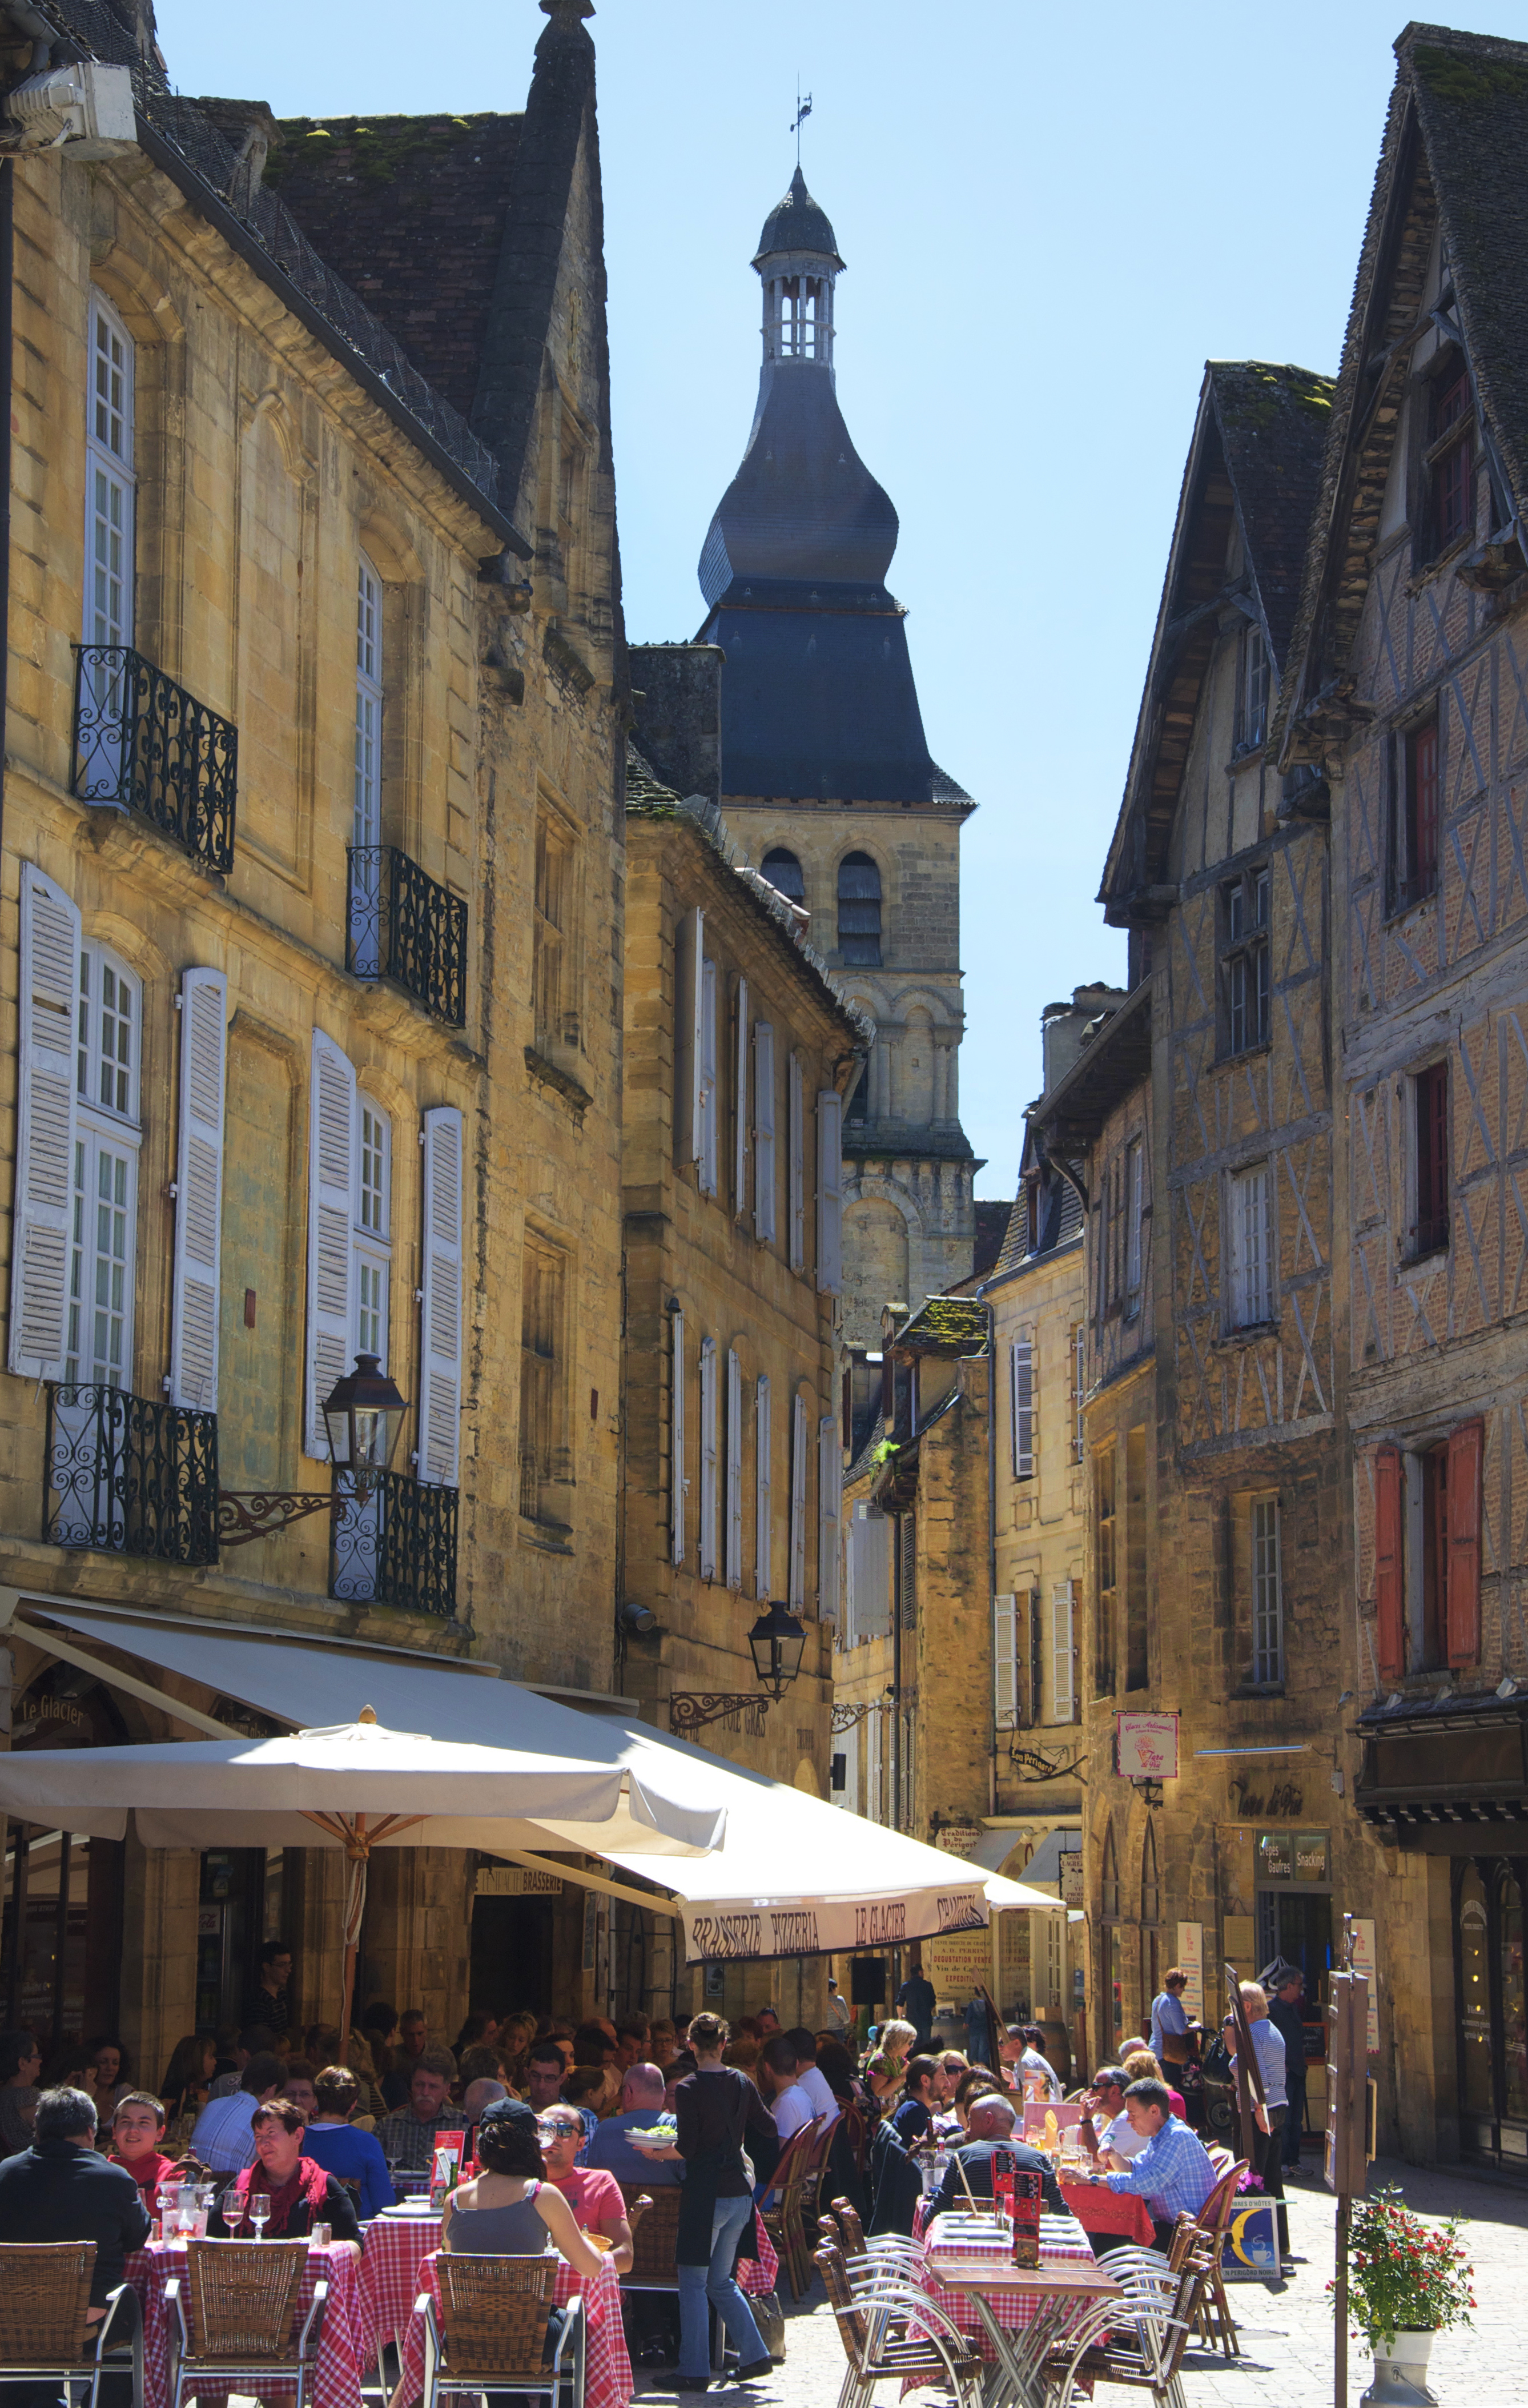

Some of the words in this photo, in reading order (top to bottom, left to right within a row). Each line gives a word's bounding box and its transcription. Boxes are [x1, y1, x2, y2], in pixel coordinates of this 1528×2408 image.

[41, 1694, 83, 1727] Glacier
[941, 1828, 980, 1836] Traditions
[1268, 1859, 1290, 1873] Gaufres
[1297, 1852, 1325, 1871] Snacking
[523, 1871, 561, 1892] BRASSERIE
[693, 1915, 762, 1959] BRASSERIE
[770, 1912, 819, 1955] PIZZERIA
[855, 1908, 867, 1945] LE
[870, 1903, 906, 1945] GLACIER
